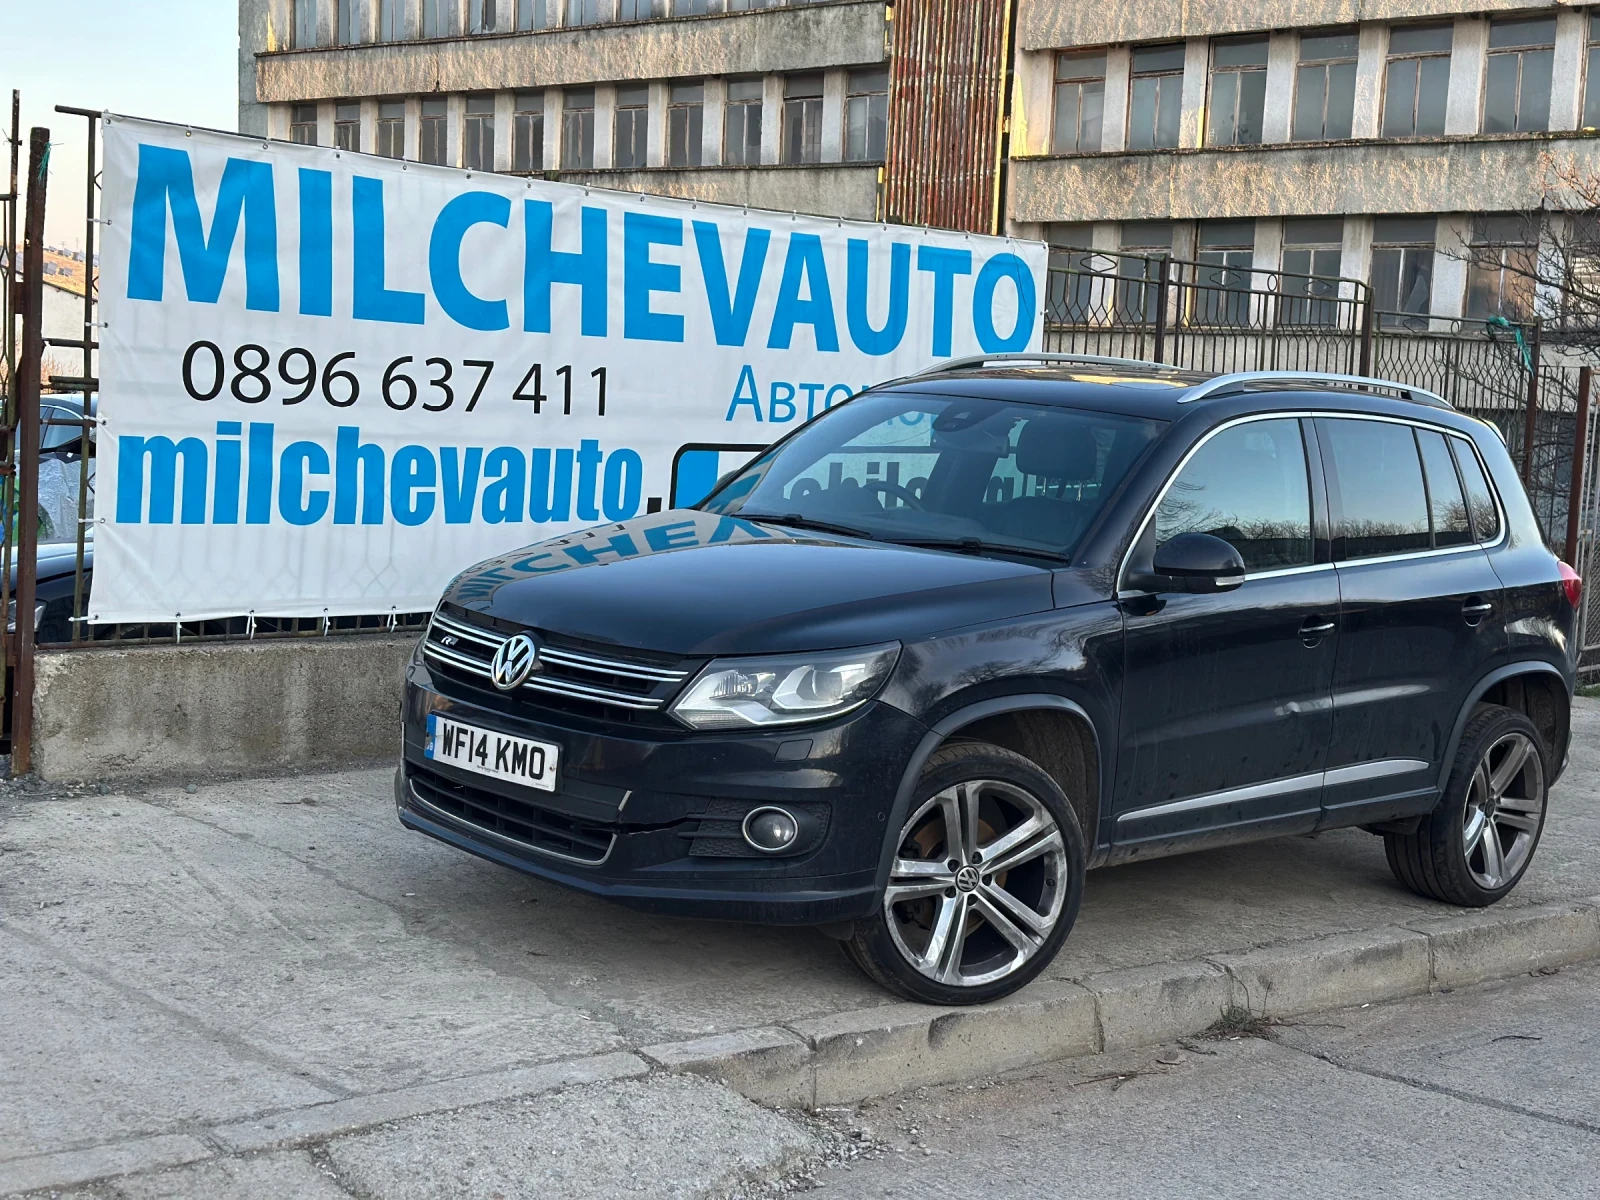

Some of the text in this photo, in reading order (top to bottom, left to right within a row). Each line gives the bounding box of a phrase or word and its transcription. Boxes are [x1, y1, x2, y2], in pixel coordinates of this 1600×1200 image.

[127, 144, 1037, 356] MILCHEVAUTO
[183, 340, 607, 417] 0896 637 411
[442, 722, 546, 781] WF14 KMO
